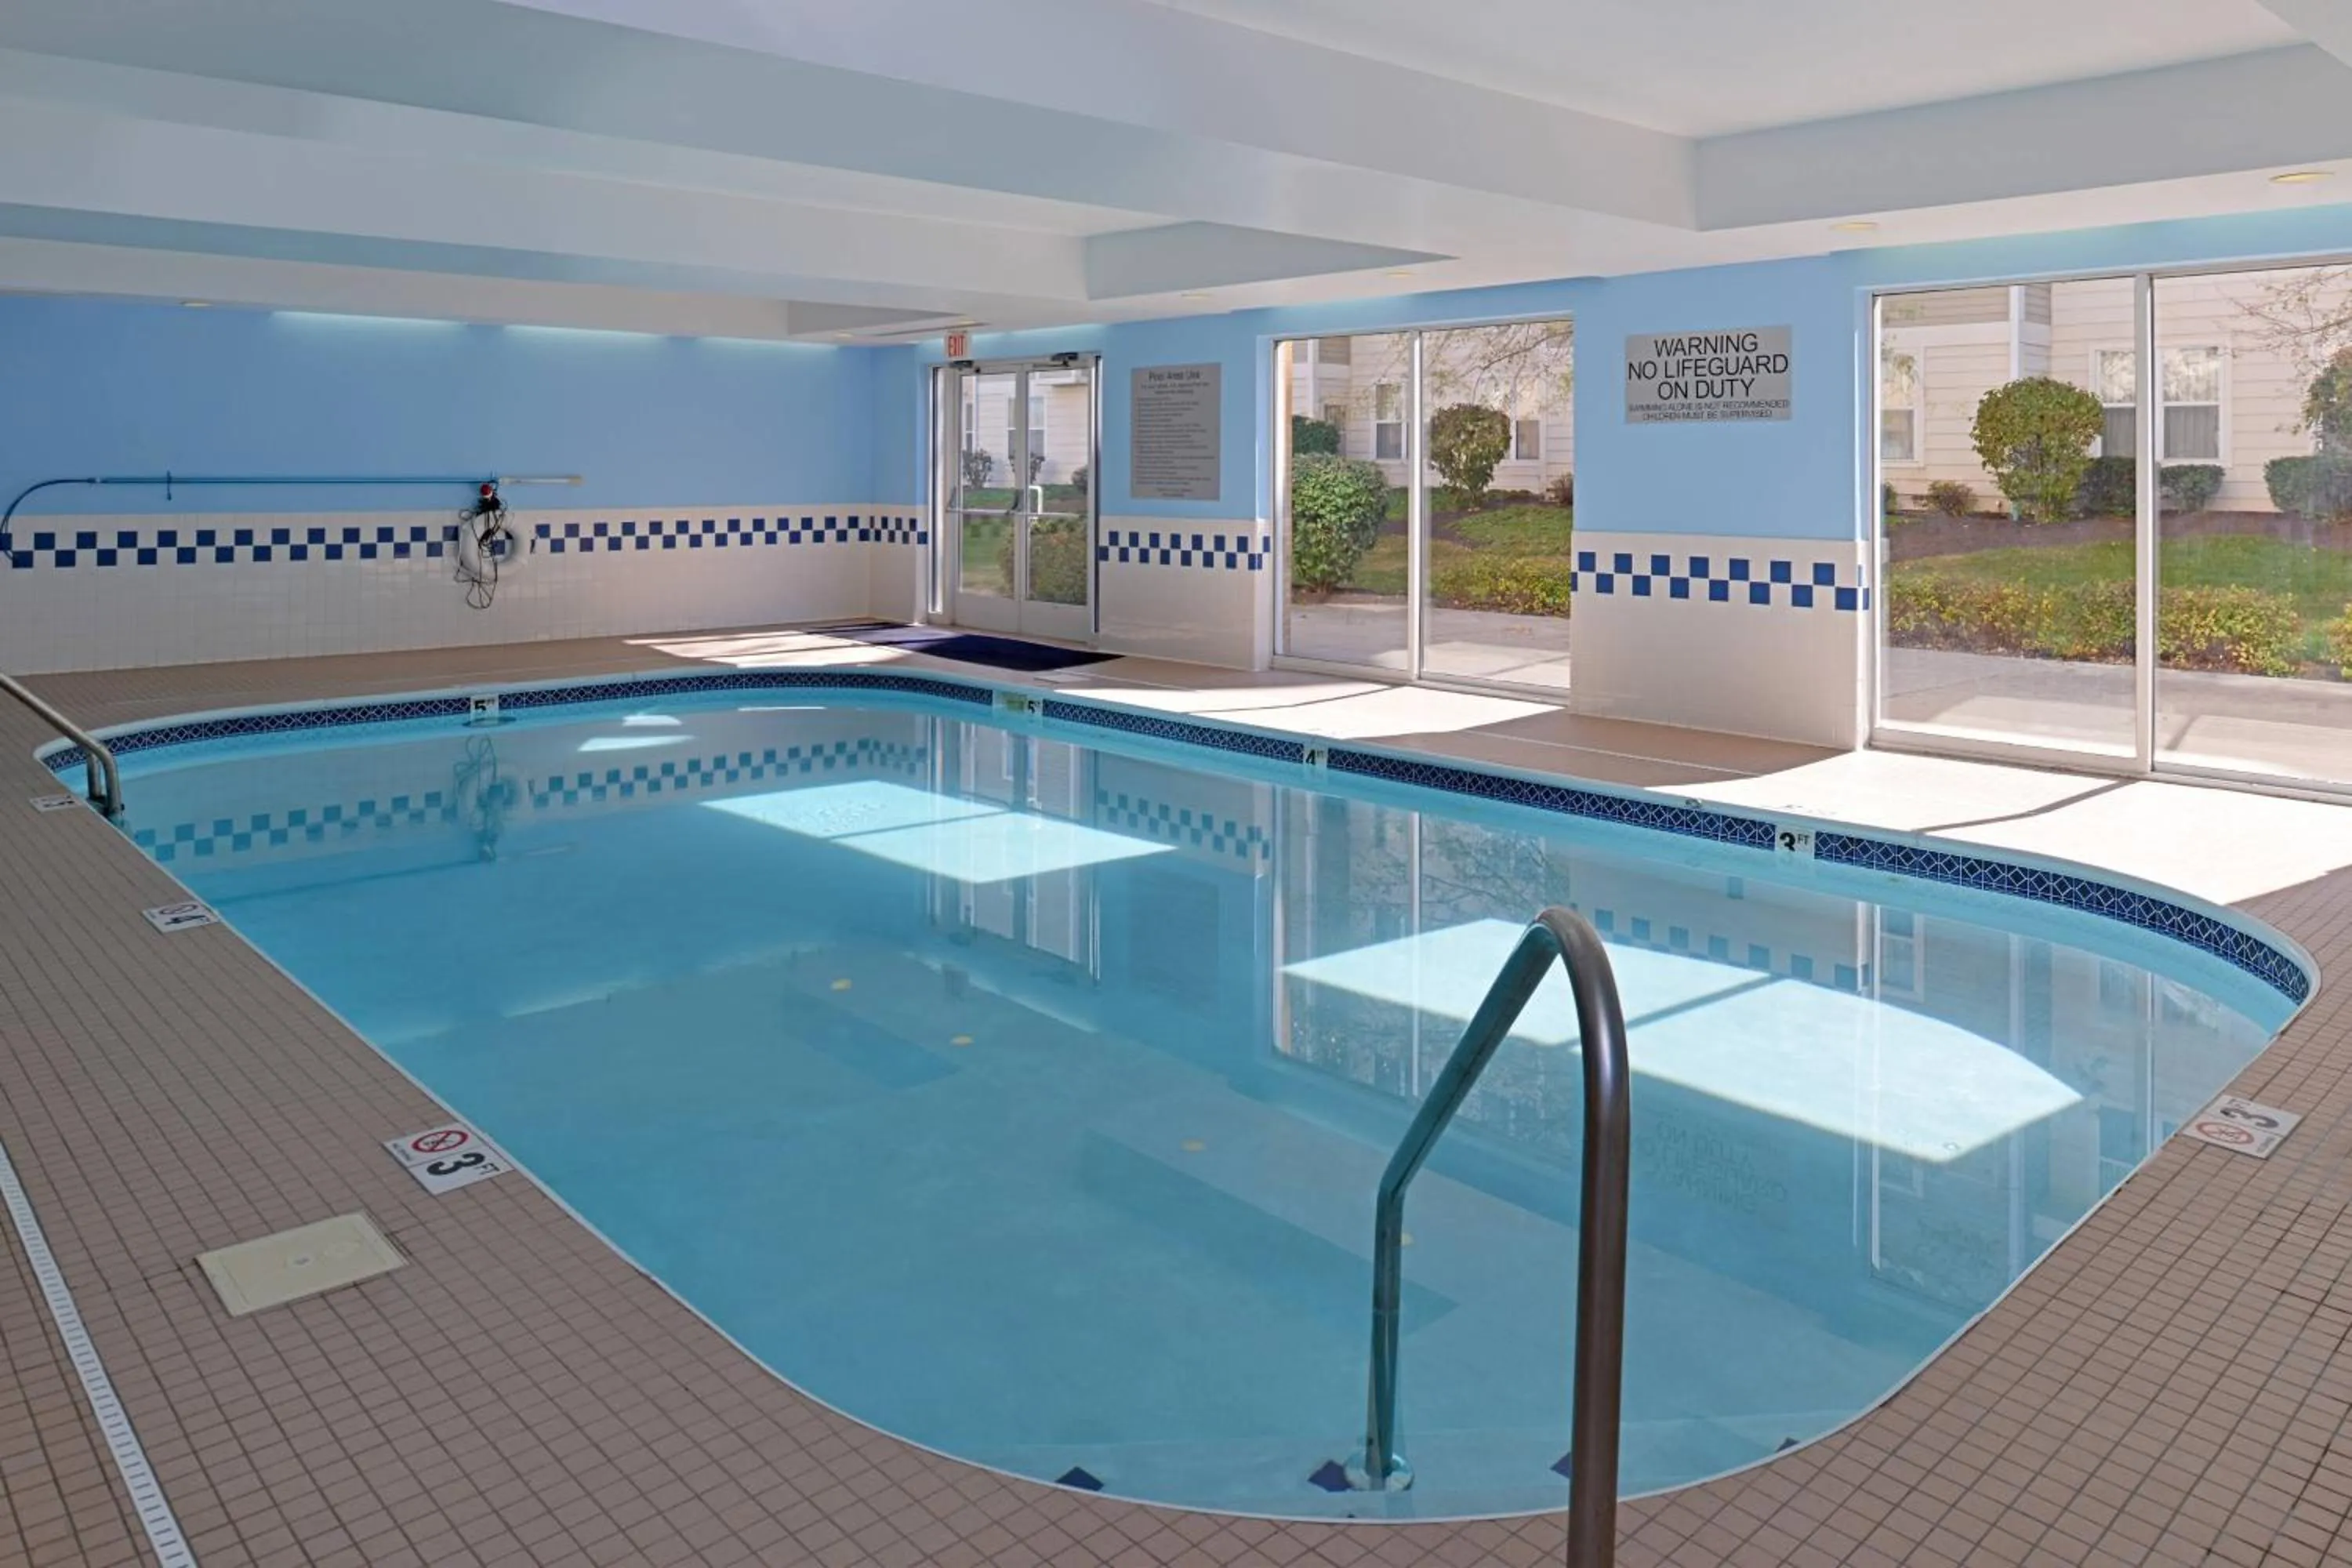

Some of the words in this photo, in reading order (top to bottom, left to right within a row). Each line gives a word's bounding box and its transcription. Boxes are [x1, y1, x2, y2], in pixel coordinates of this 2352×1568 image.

[948, 335, 964, 358] EXIT
[1654, 333, 1759, 358] WARNING
[1628, 361, 1657, 380] NO
[1664, 354, 1788, 379] LIFEGUARD
[1657, 381, 1688, 400] ON
[1696, 378, 1755, 398] DUTY
[2220, 1107, 2279, 1128] 3
[426, 1152, 485, 1176] 3
